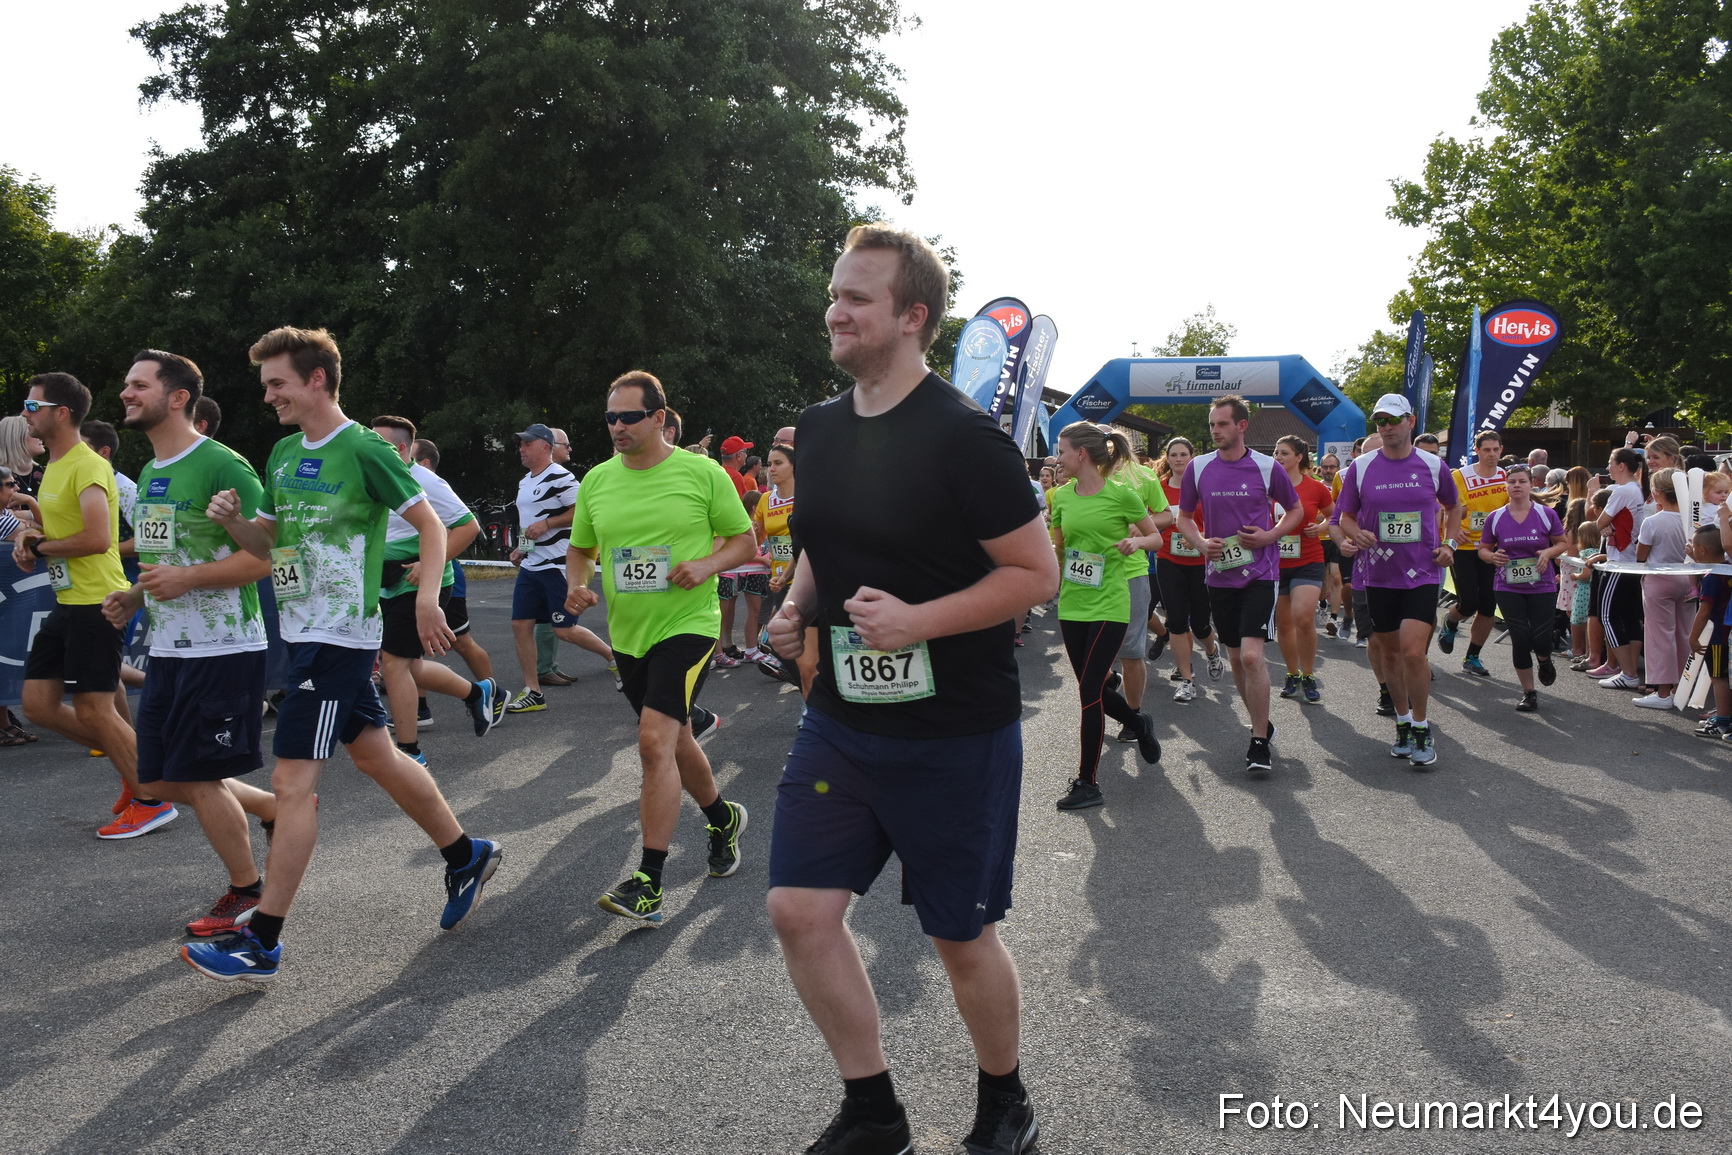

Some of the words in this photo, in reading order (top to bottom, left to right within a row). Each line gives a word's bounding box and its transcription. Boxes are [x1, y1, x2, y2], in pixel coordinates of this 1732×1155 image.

[998, 313, 1023, 333] rvis
[1493, 317, 1550, 338] Hervis
[989, 344, 1020, 416] MOVIN
[1187, 380, 1242, 391] firmenlauf
[278, 475, 344, 496] firmenlauf
[1468, 490, 1488, 499] MAX
[298, 501, 328, 511] Firmen
[1388, 523, 1412, 535] 878
[1474, 518, 1485, 526] 15
[138, 521, 168, 540] 1622
[773, 544, 793, 555] 1553
[49, 565, 64, 581] 93
[623, 563, 657, 580] 452
[1070, 561, 1094, 577] 446
[1512, 566, 1532, 577] 903
[844, 652, 914, 682] 1867
[848, 681, 890, 690] Schuhmann
[891, 680, 919, 689] Philipp
